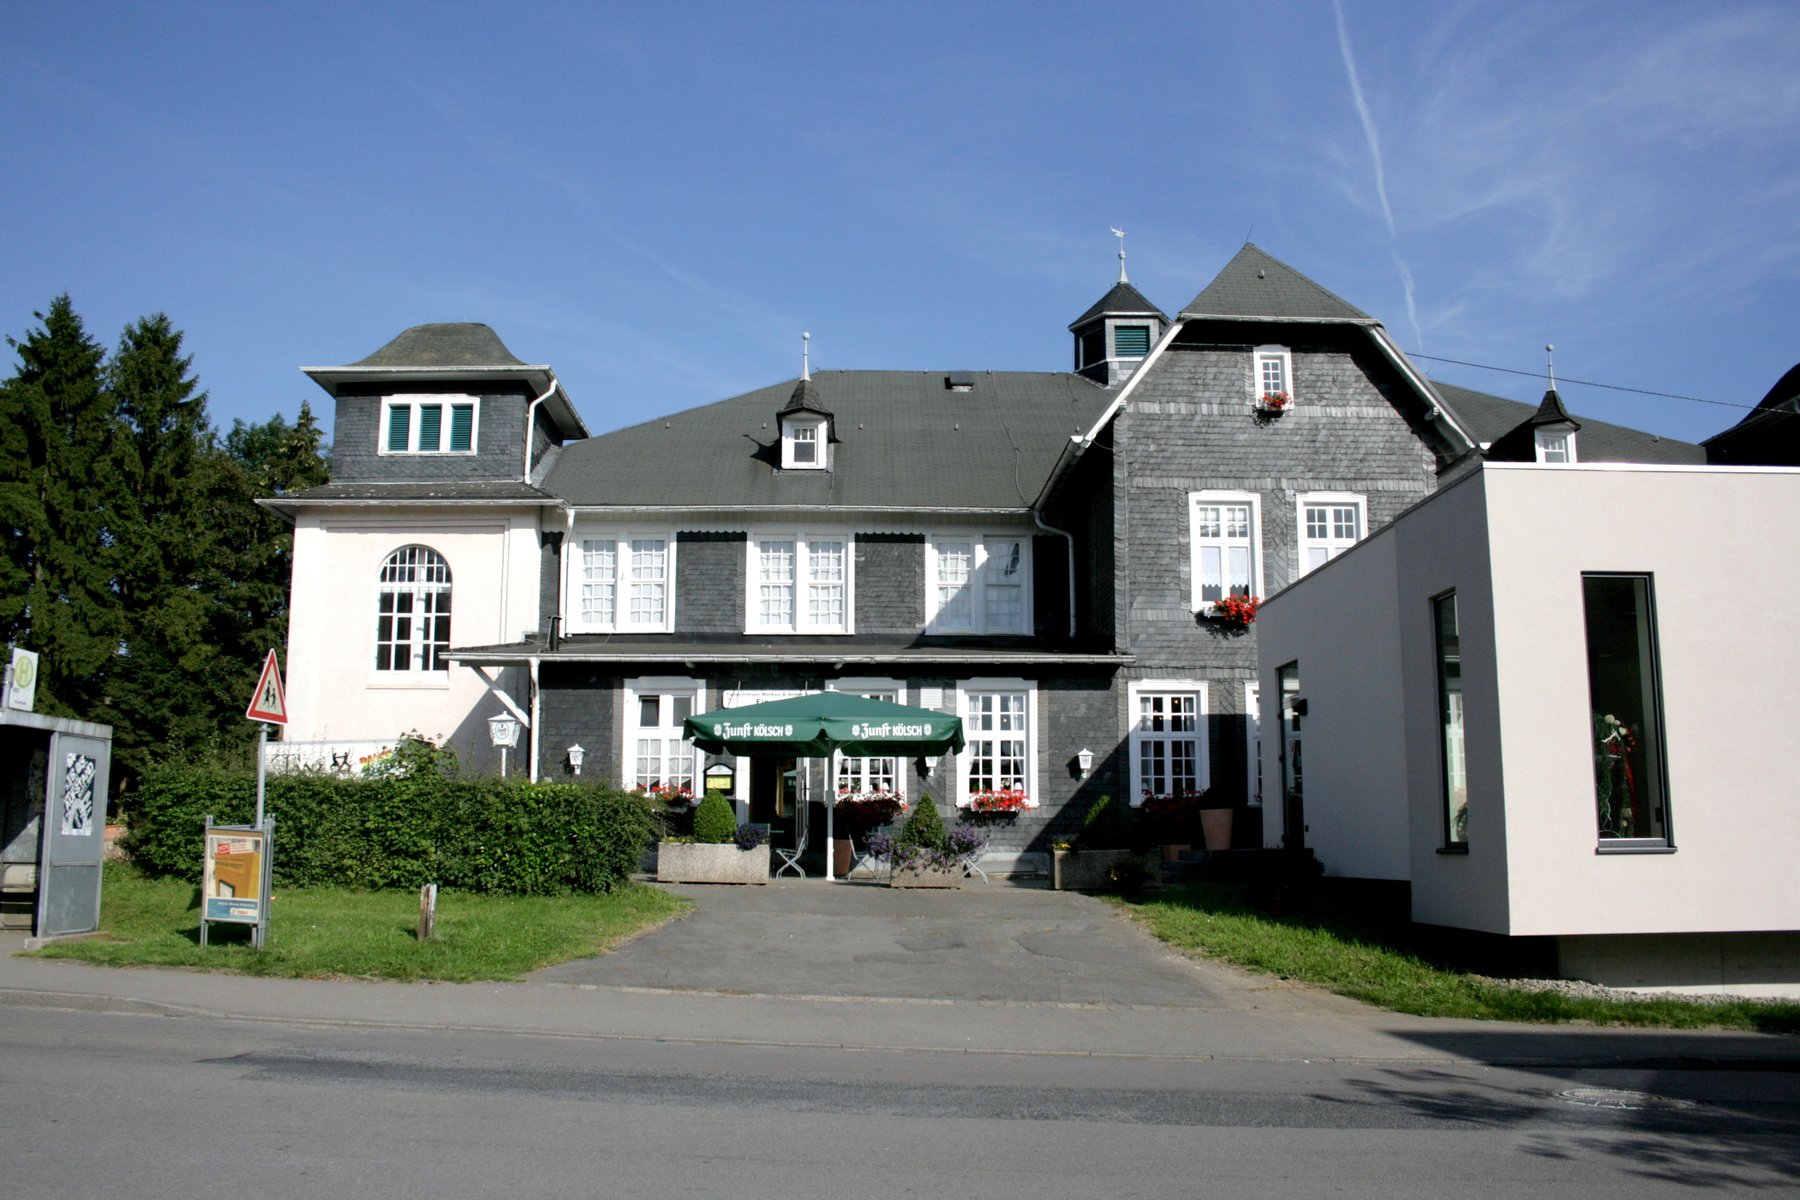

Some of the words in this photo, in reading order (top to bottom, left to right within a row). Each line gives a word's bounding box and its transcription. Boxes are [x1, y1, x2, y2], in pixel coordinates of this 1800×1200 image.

[723, 722, 753, 740] Zunft
[753, 723, 784, 737] KÖLSCH
[861, 722, 892, 739] Zunft
[892, 723, 923, 737] KÖLSCH
